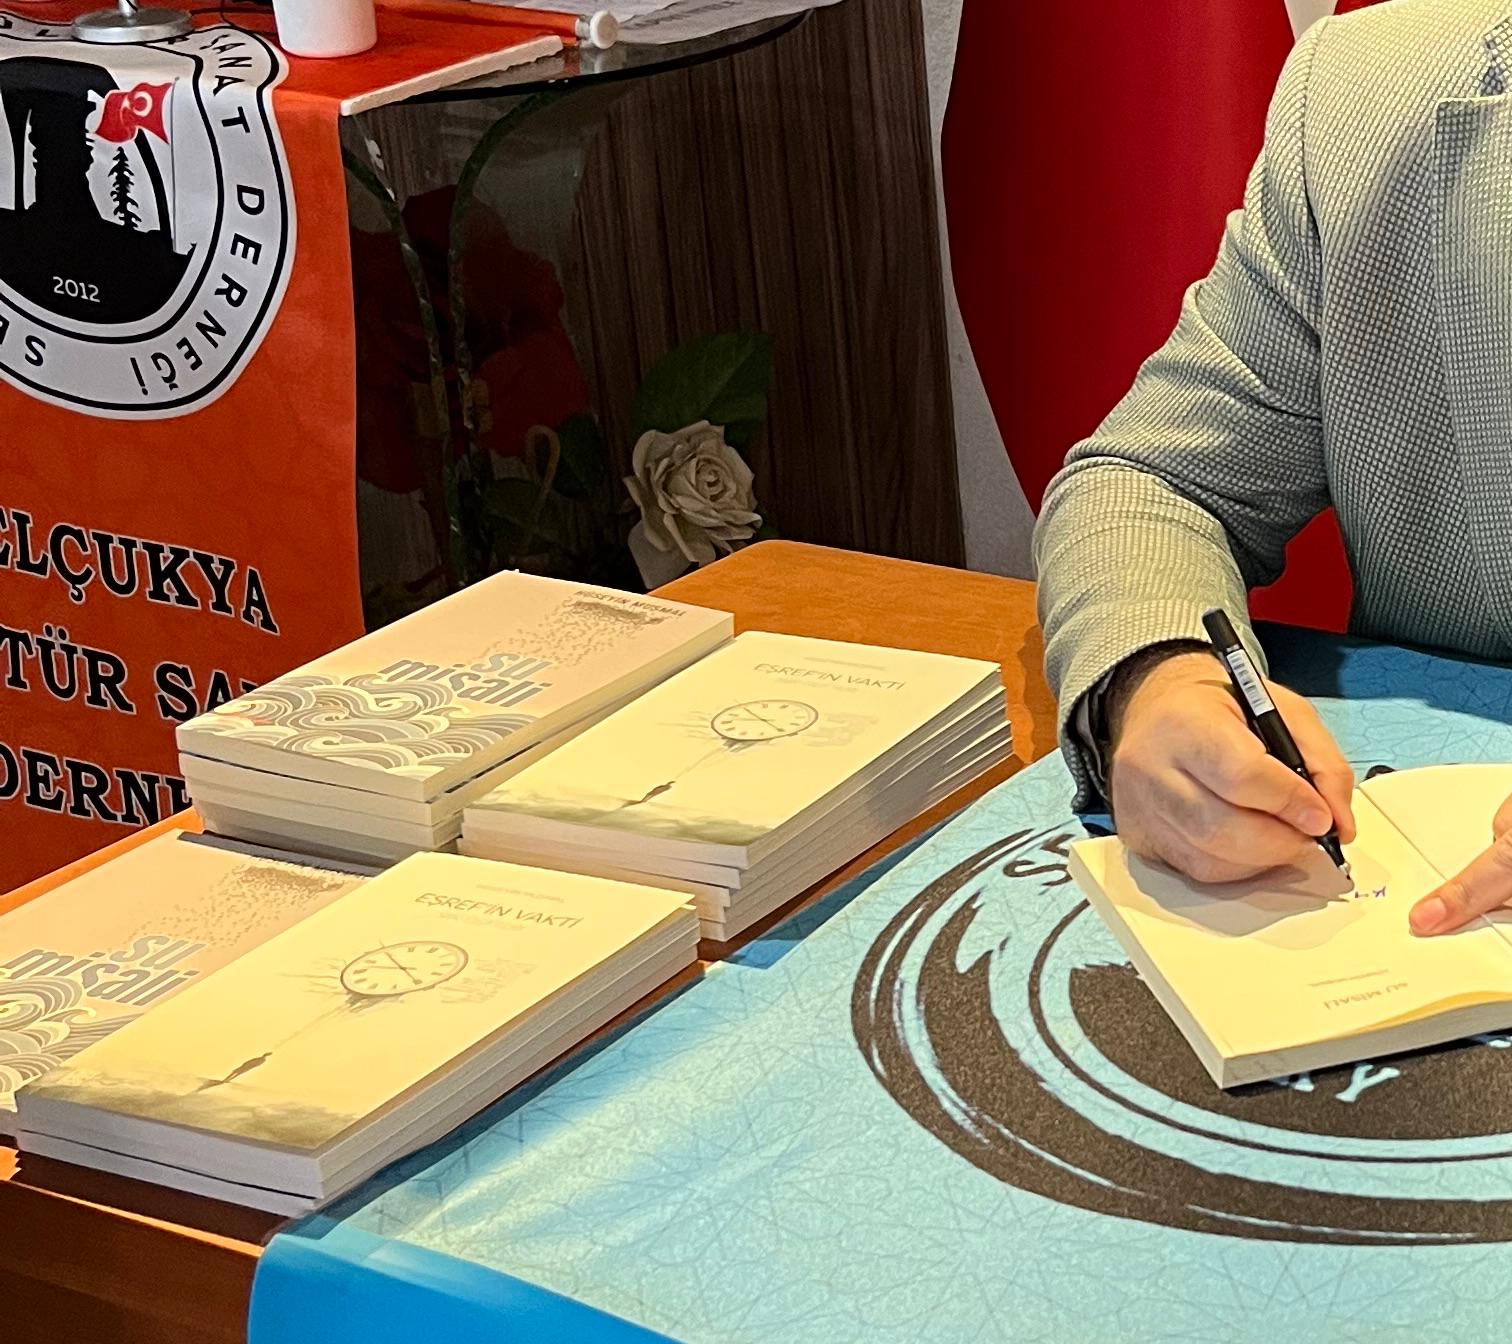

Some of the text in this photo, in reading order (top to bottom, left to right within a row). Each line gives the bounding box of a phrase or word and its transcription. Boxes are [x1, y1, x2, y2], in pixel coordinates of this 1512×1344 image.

[52, 276, 101, 303] 2012
[130, 184, 265, 396] DERNEĞİ
[0, 623, 136, 714] TÜR
